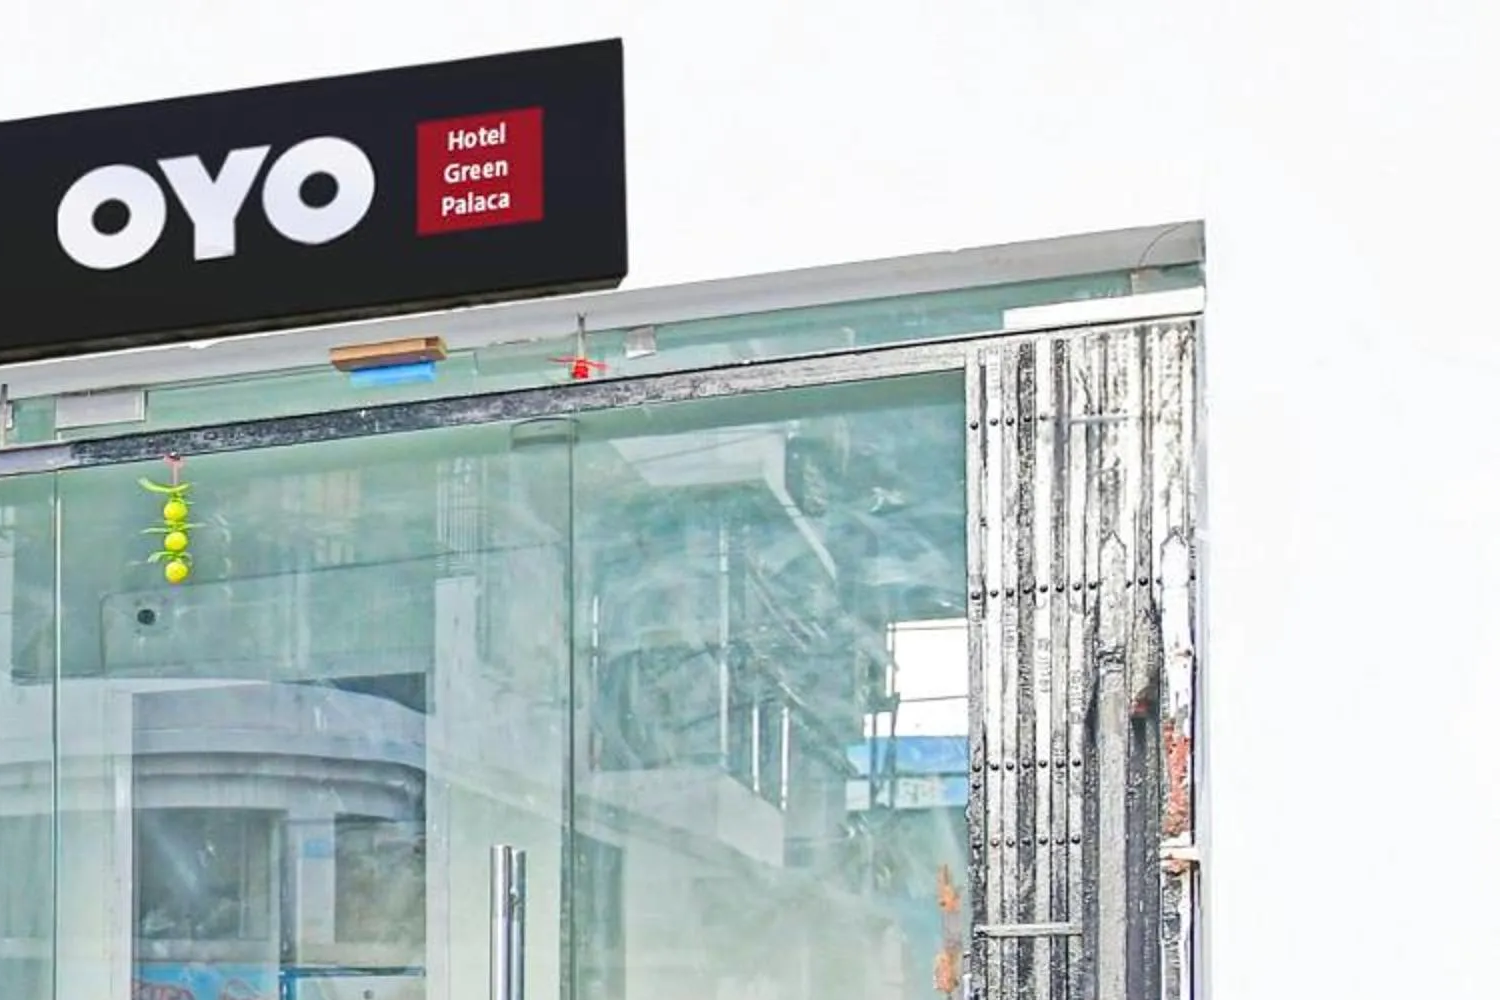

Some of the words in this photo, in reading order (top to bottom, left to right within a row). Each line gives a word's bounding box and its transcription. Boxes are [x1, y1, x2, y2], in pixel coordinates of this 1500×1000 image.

[447, 121, 506, 151] Hotel
[443, 160, 509, 184] Green
[56, 135, 376, 271] OYO
[441, 191, 511, 217] Palaca
